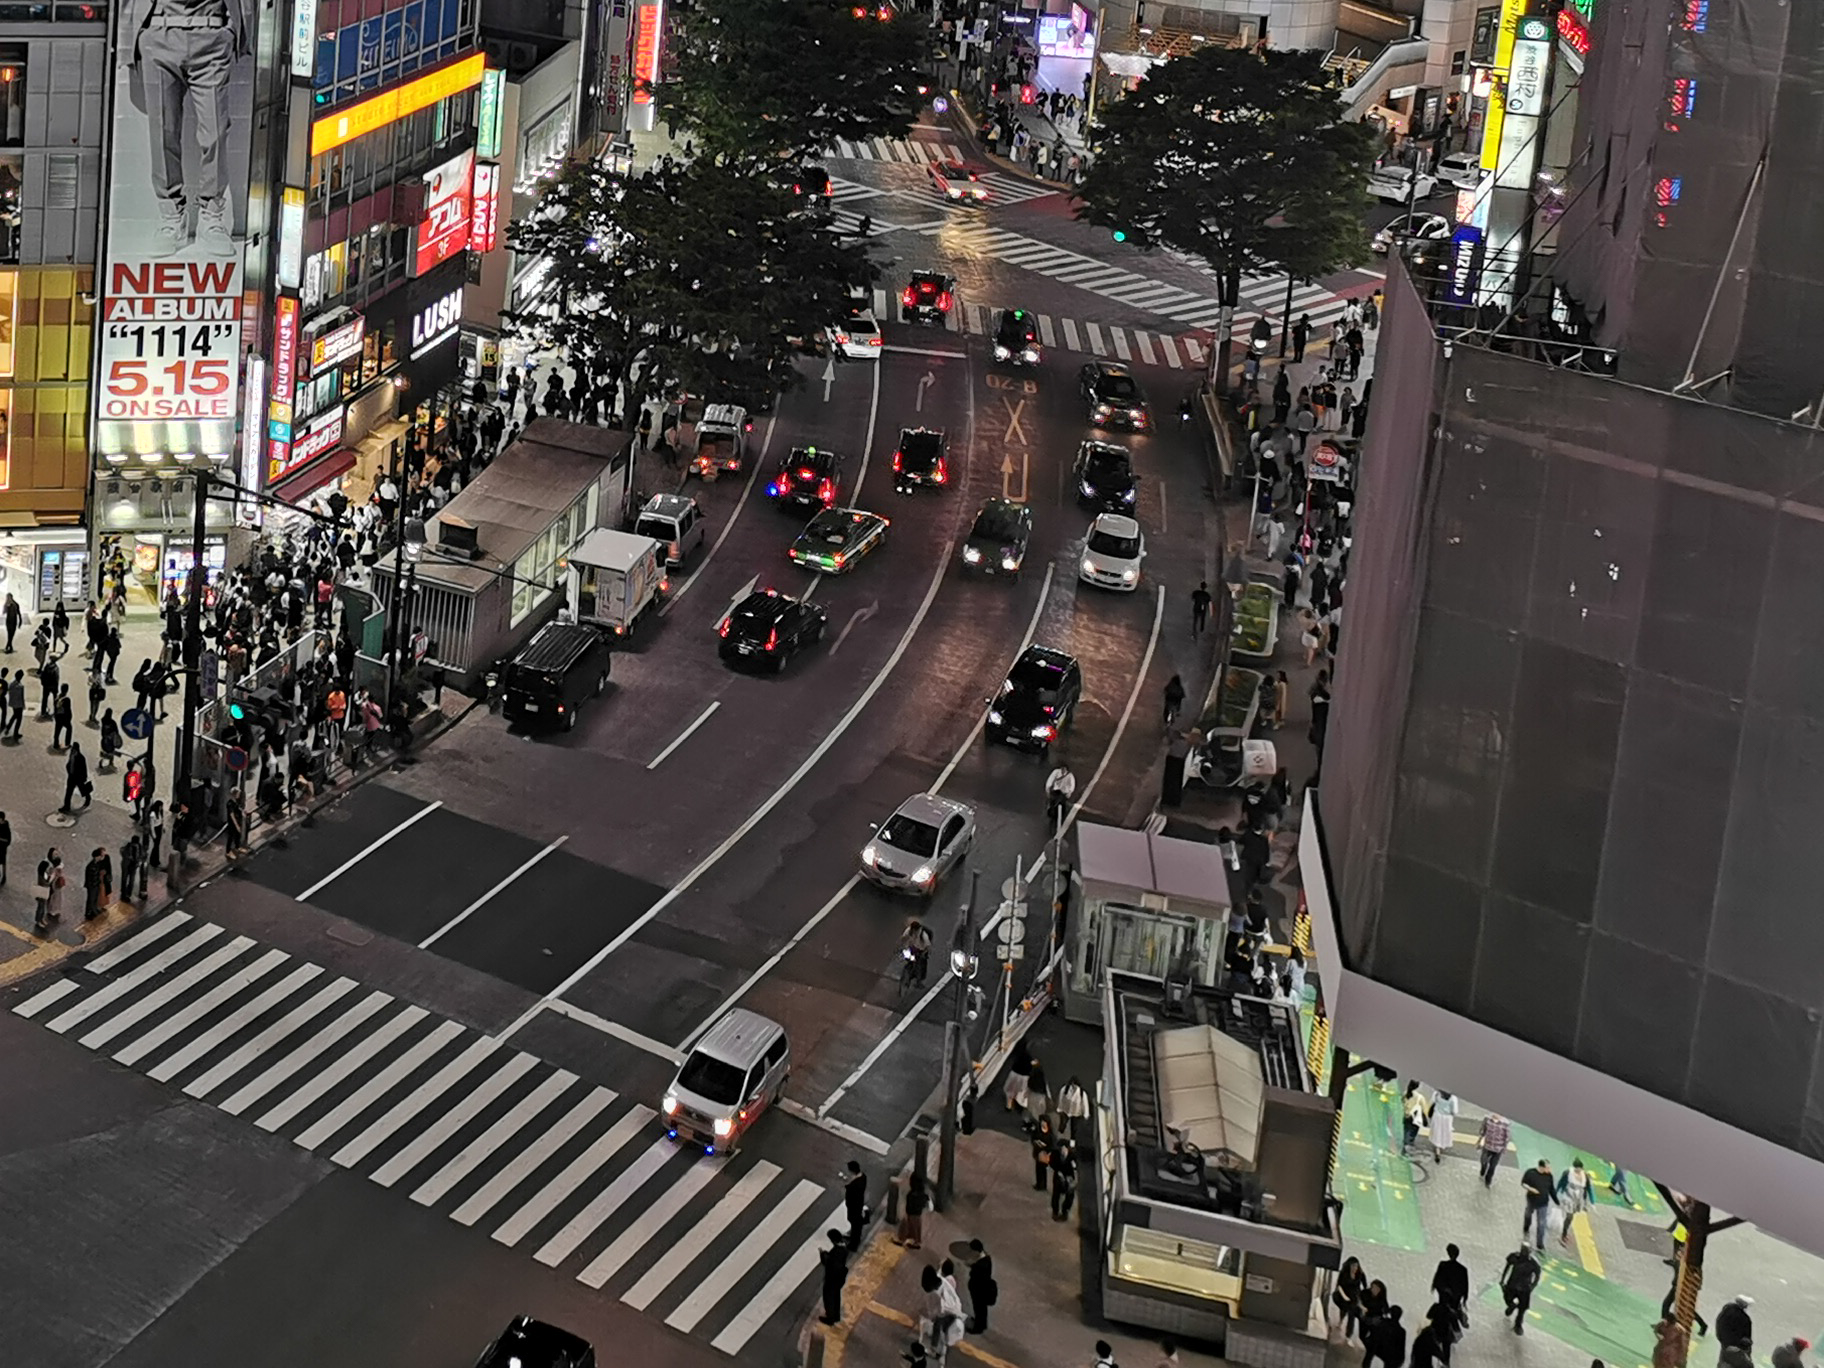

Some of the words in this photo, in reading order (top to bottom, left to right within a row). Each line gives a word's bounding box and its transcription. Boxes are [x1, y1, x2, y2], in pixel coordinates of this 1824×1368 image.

[428, 199, 463, 238] アコム
[112, 262, 237, 294] NEW
[109, 298, 235, 320] ALBUM
[412, 287, 463, 348] LUSH
[107, 360, 229, 396] 5.15
[107, 399, 151, 416] ON
[154, 399, 228, 416] SALE
